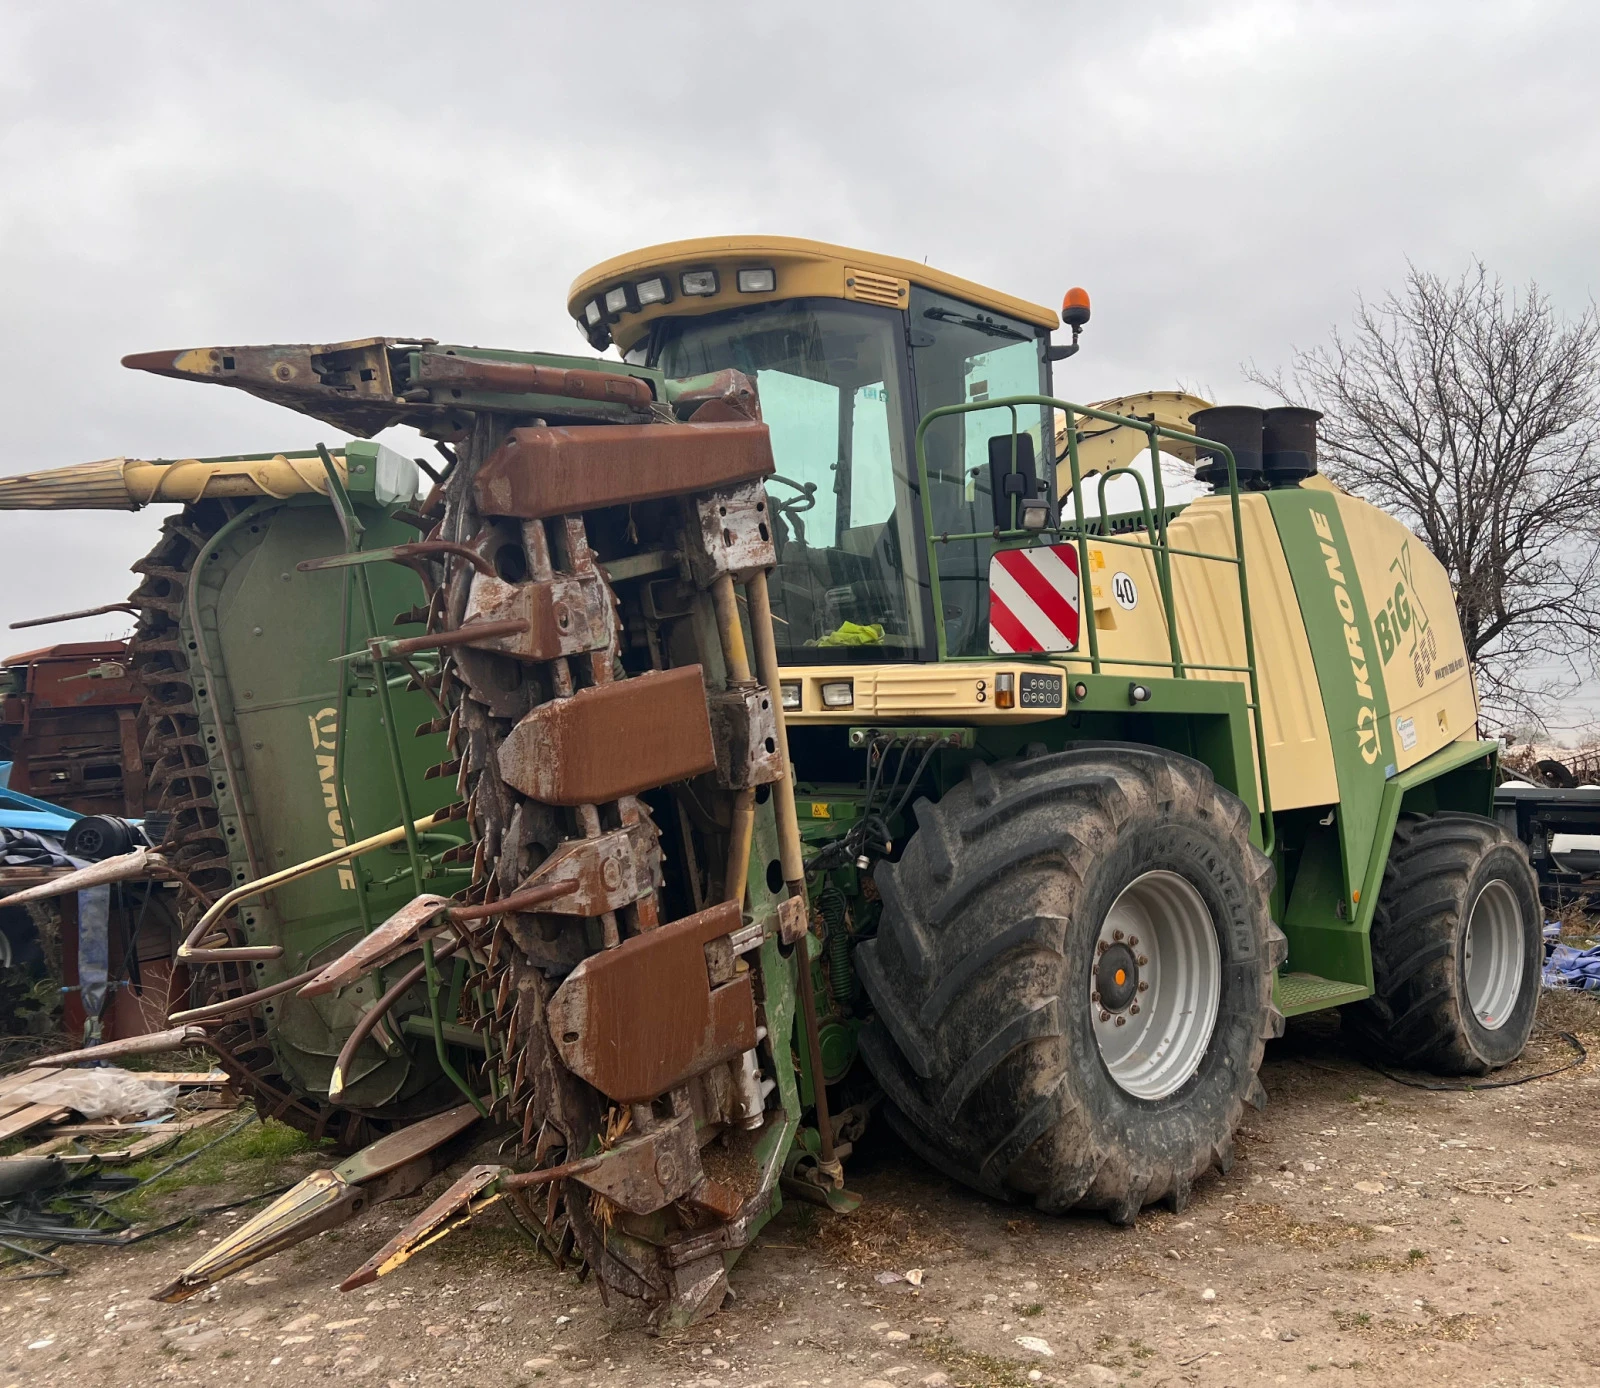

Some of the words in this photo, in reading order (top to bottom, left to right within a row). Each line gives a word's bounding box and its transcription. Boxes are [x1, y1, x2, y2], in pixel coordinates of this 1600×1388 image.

[1115, 578, 1135, 604] 40
[1308, 508, 1374, 700] KRONE
[1414, 626, 1437, 688] 650
[1183, 840, 1252, 952] MICHELIN
